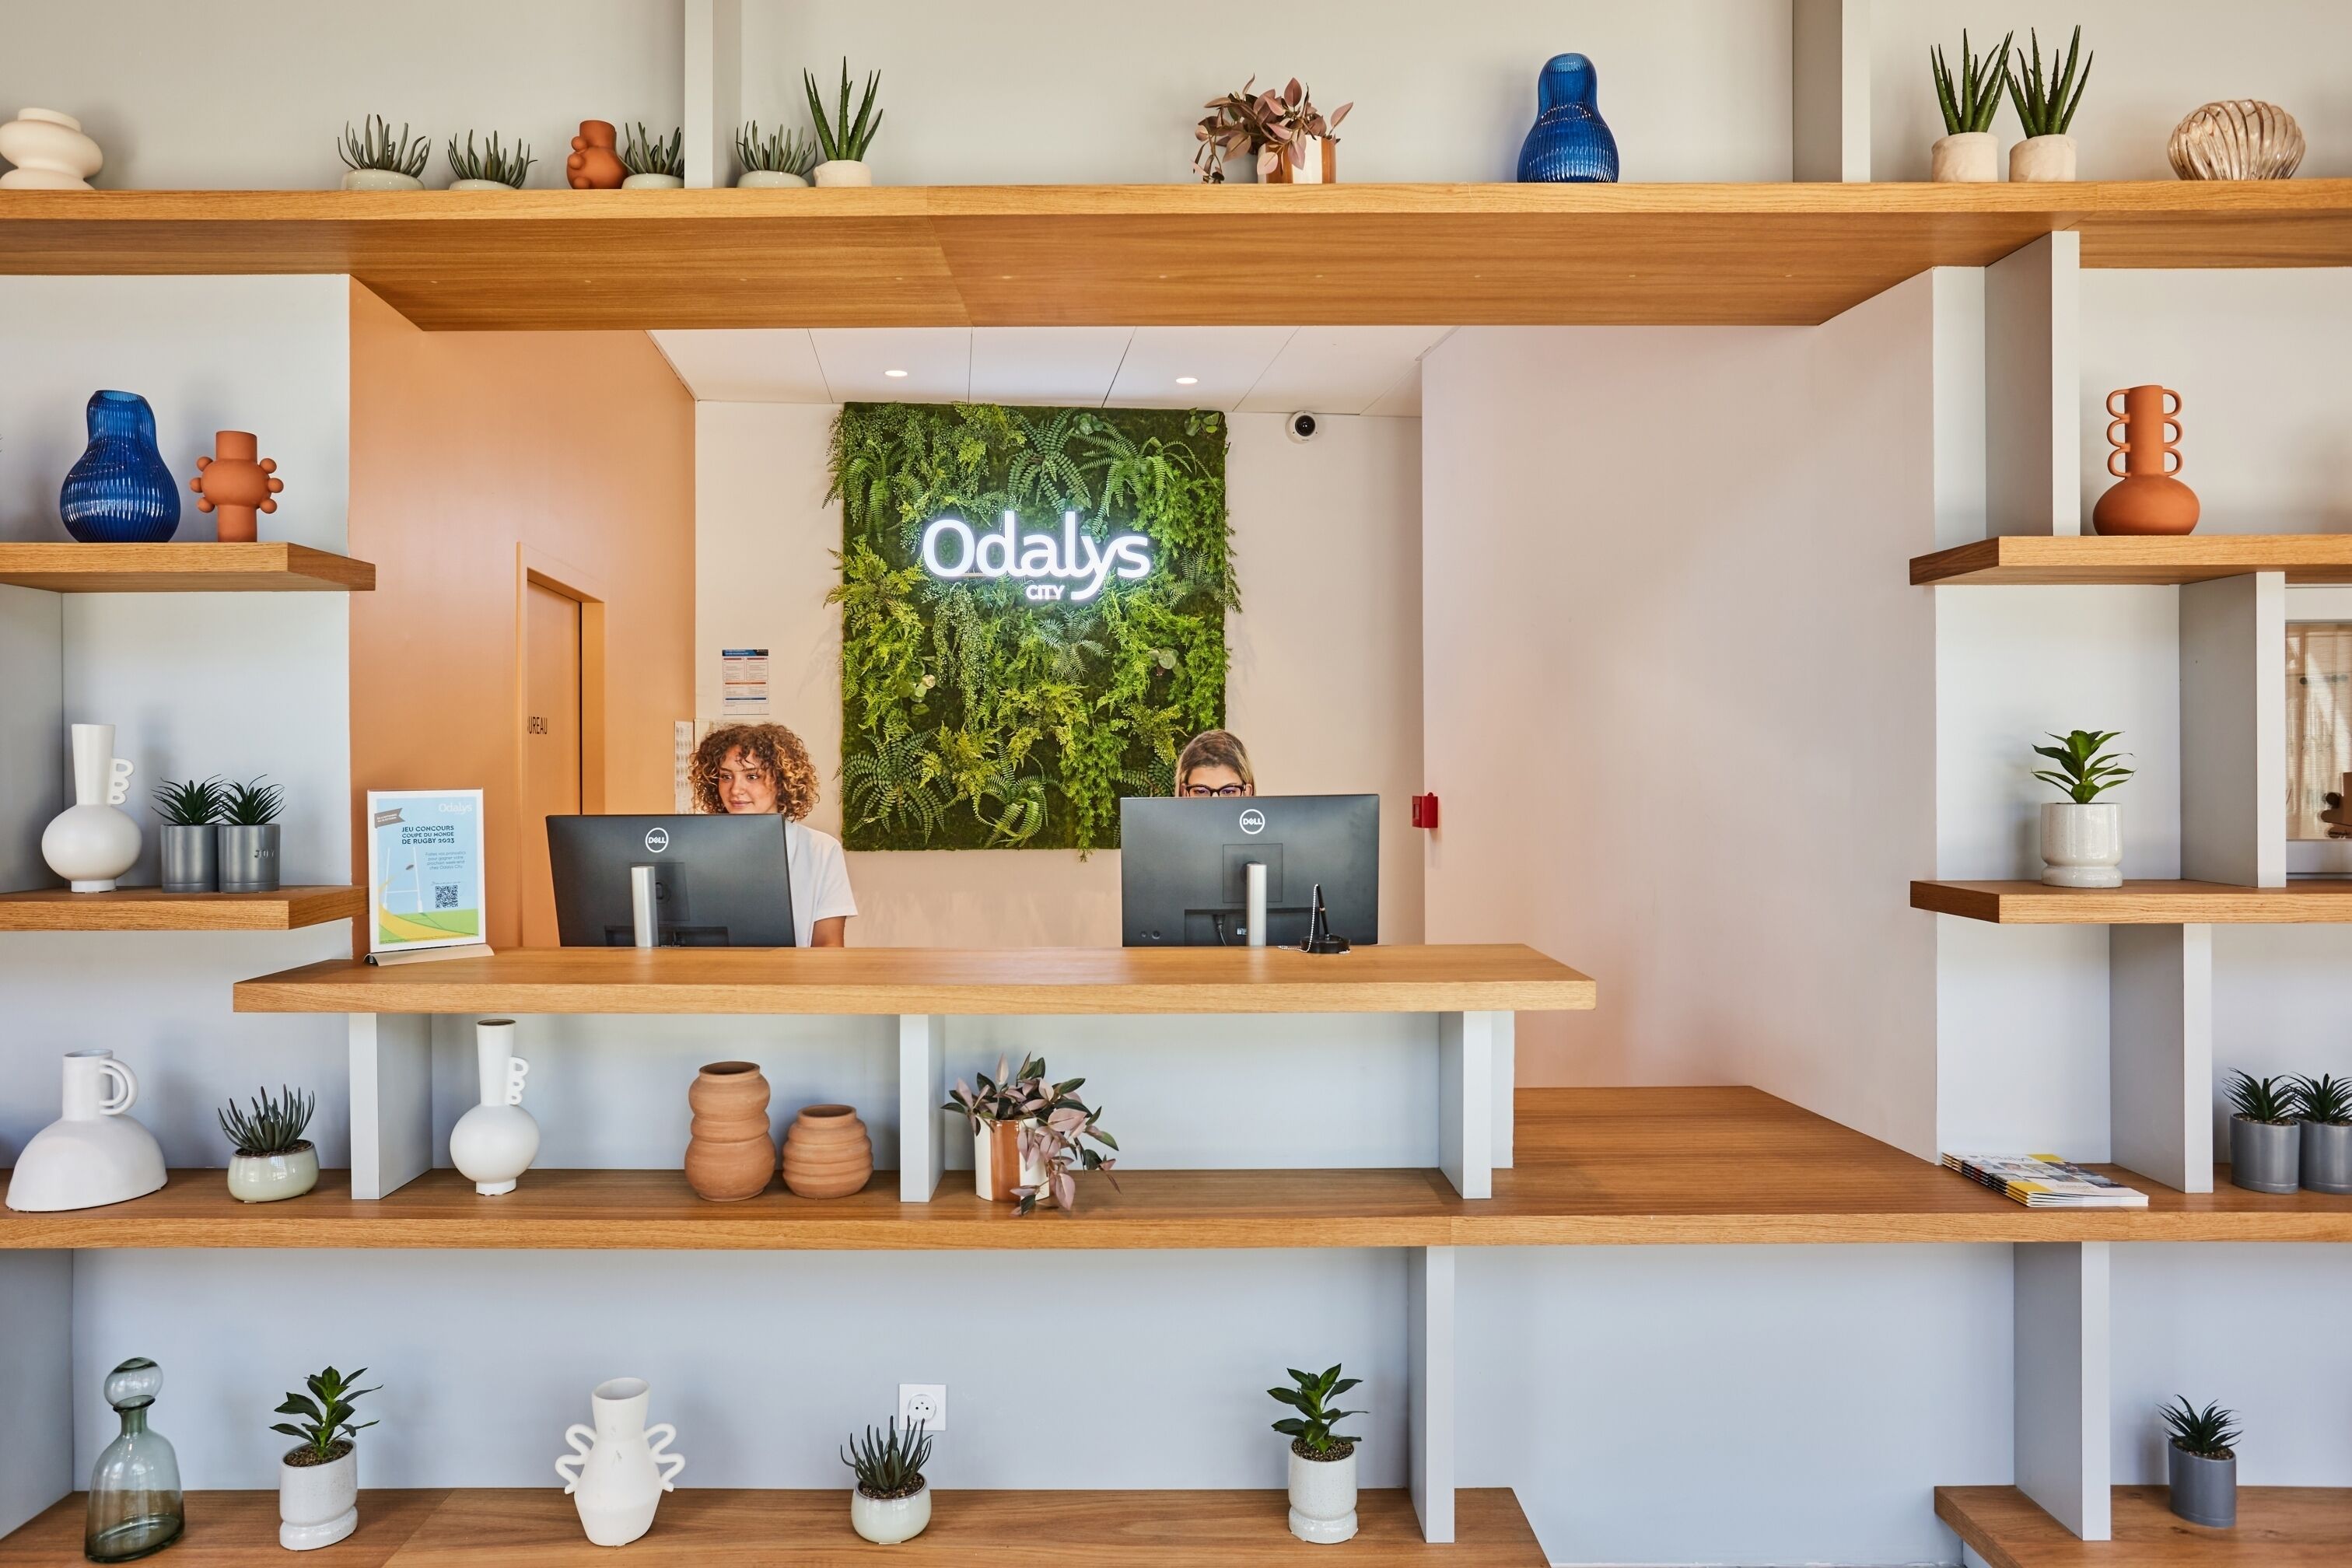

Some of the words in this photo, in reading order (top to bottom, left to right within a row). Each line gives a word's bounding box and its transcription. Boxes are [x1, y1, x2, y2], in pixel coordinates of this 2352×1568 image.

[922, 510, 1151, 600] Odalys
[1025, 585, 1066, 600] CITY
[438, 802, 473, 815] Odalys
